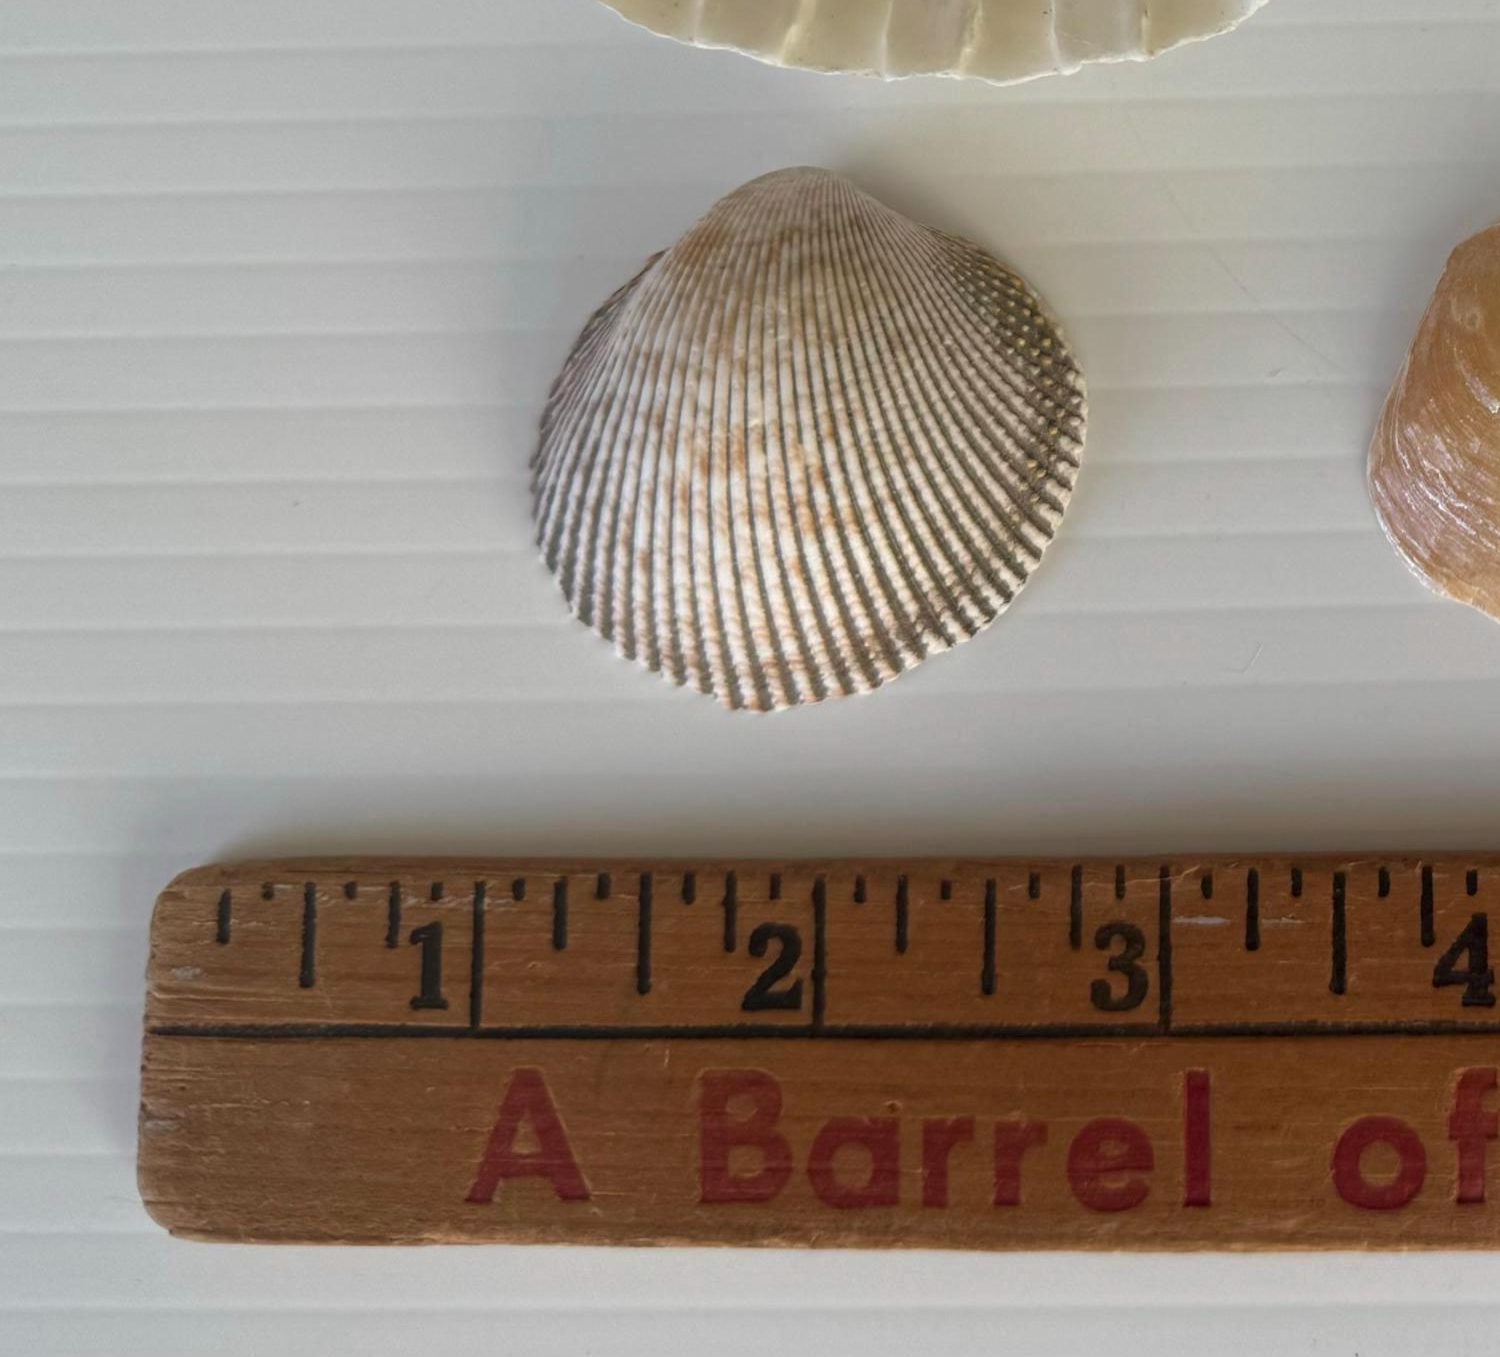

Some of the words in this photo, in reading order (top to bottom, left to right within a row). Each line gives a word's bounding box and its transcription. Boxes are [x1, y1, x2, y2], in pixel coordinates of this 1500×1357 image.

[409, 921, 449, 1011] 1
[740, 923, 802, 1012] 2
[1089, 922, 1149, 1012] 3
[1432, 912, 1496, 1007] 4
[465, 1068, 591, 1204] A
[697, 1067, 1212, 1211] Barrel
[1331, 1066, 1500, 1210] of
